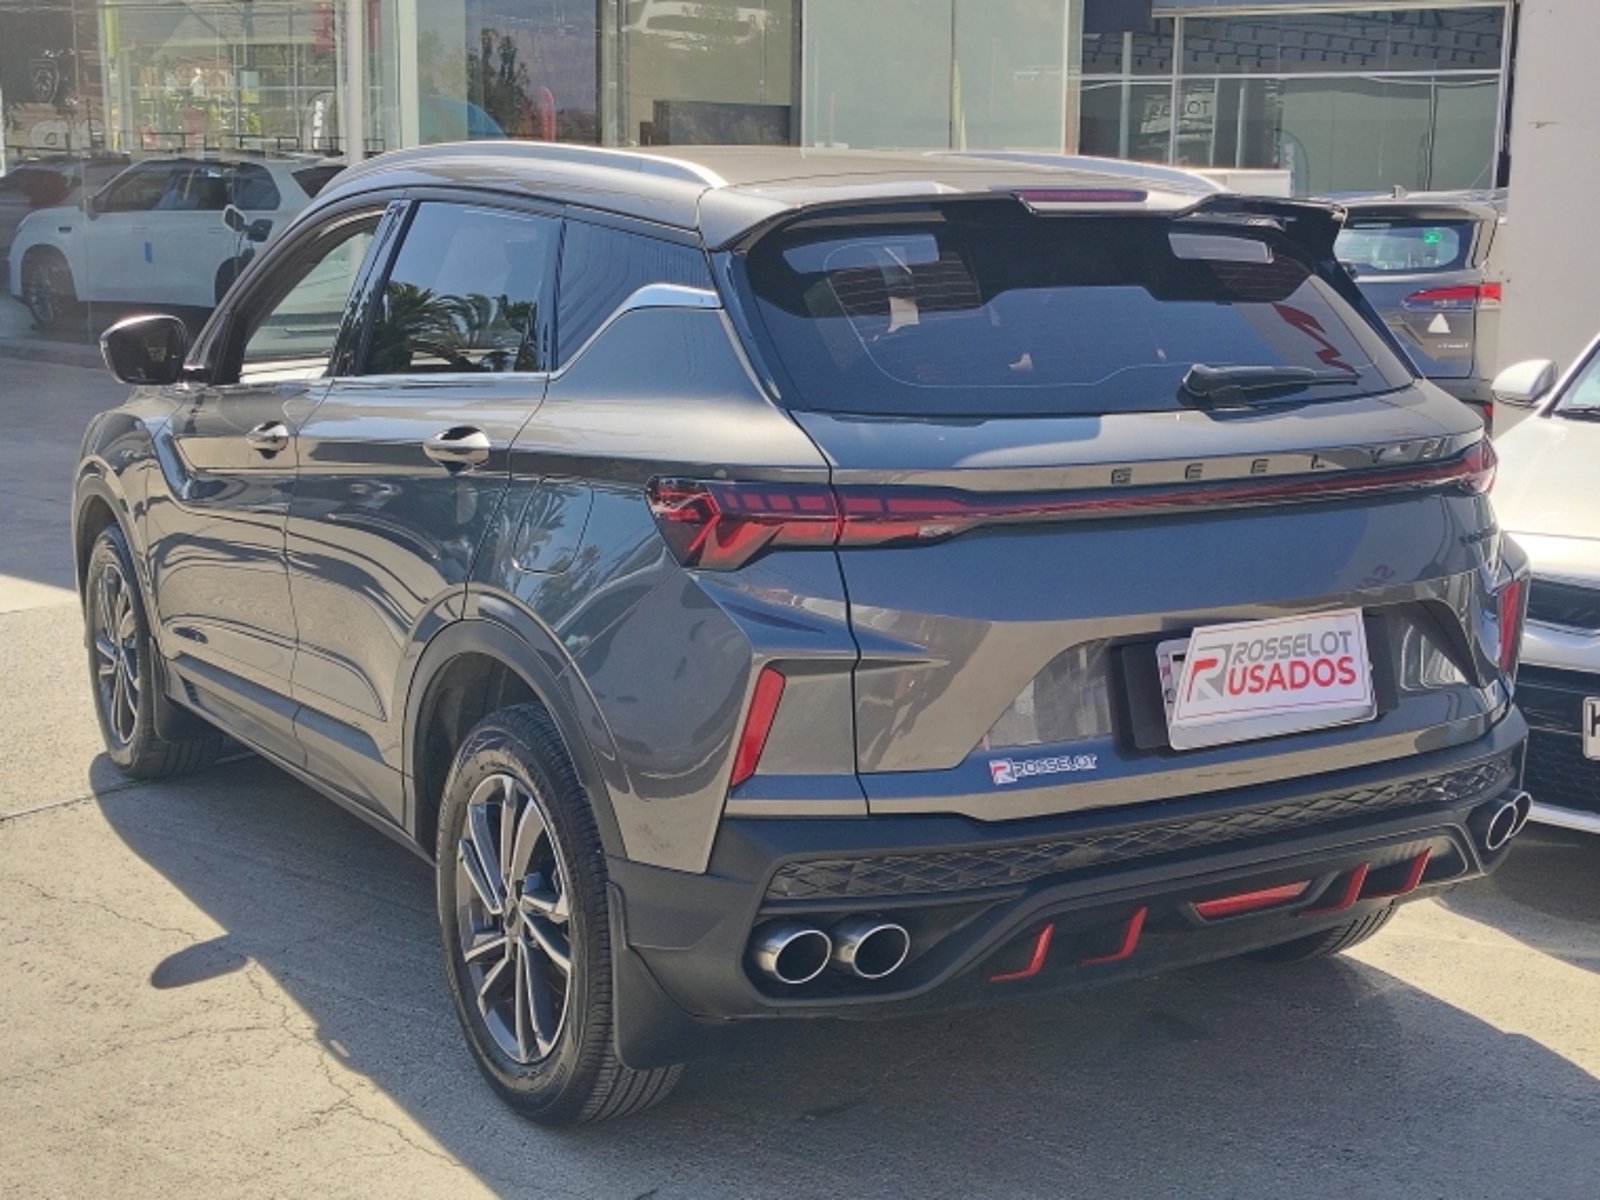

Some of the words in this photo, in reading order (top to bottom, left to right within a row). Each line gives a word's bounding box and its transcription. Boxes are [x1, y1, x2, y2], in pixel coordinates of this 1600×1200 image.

[1111, 448, 1386, 485] GEELY
[1232, 631, 1352, 665] ROSSELOT
[1228, 656, 1356, 696] USADOS
